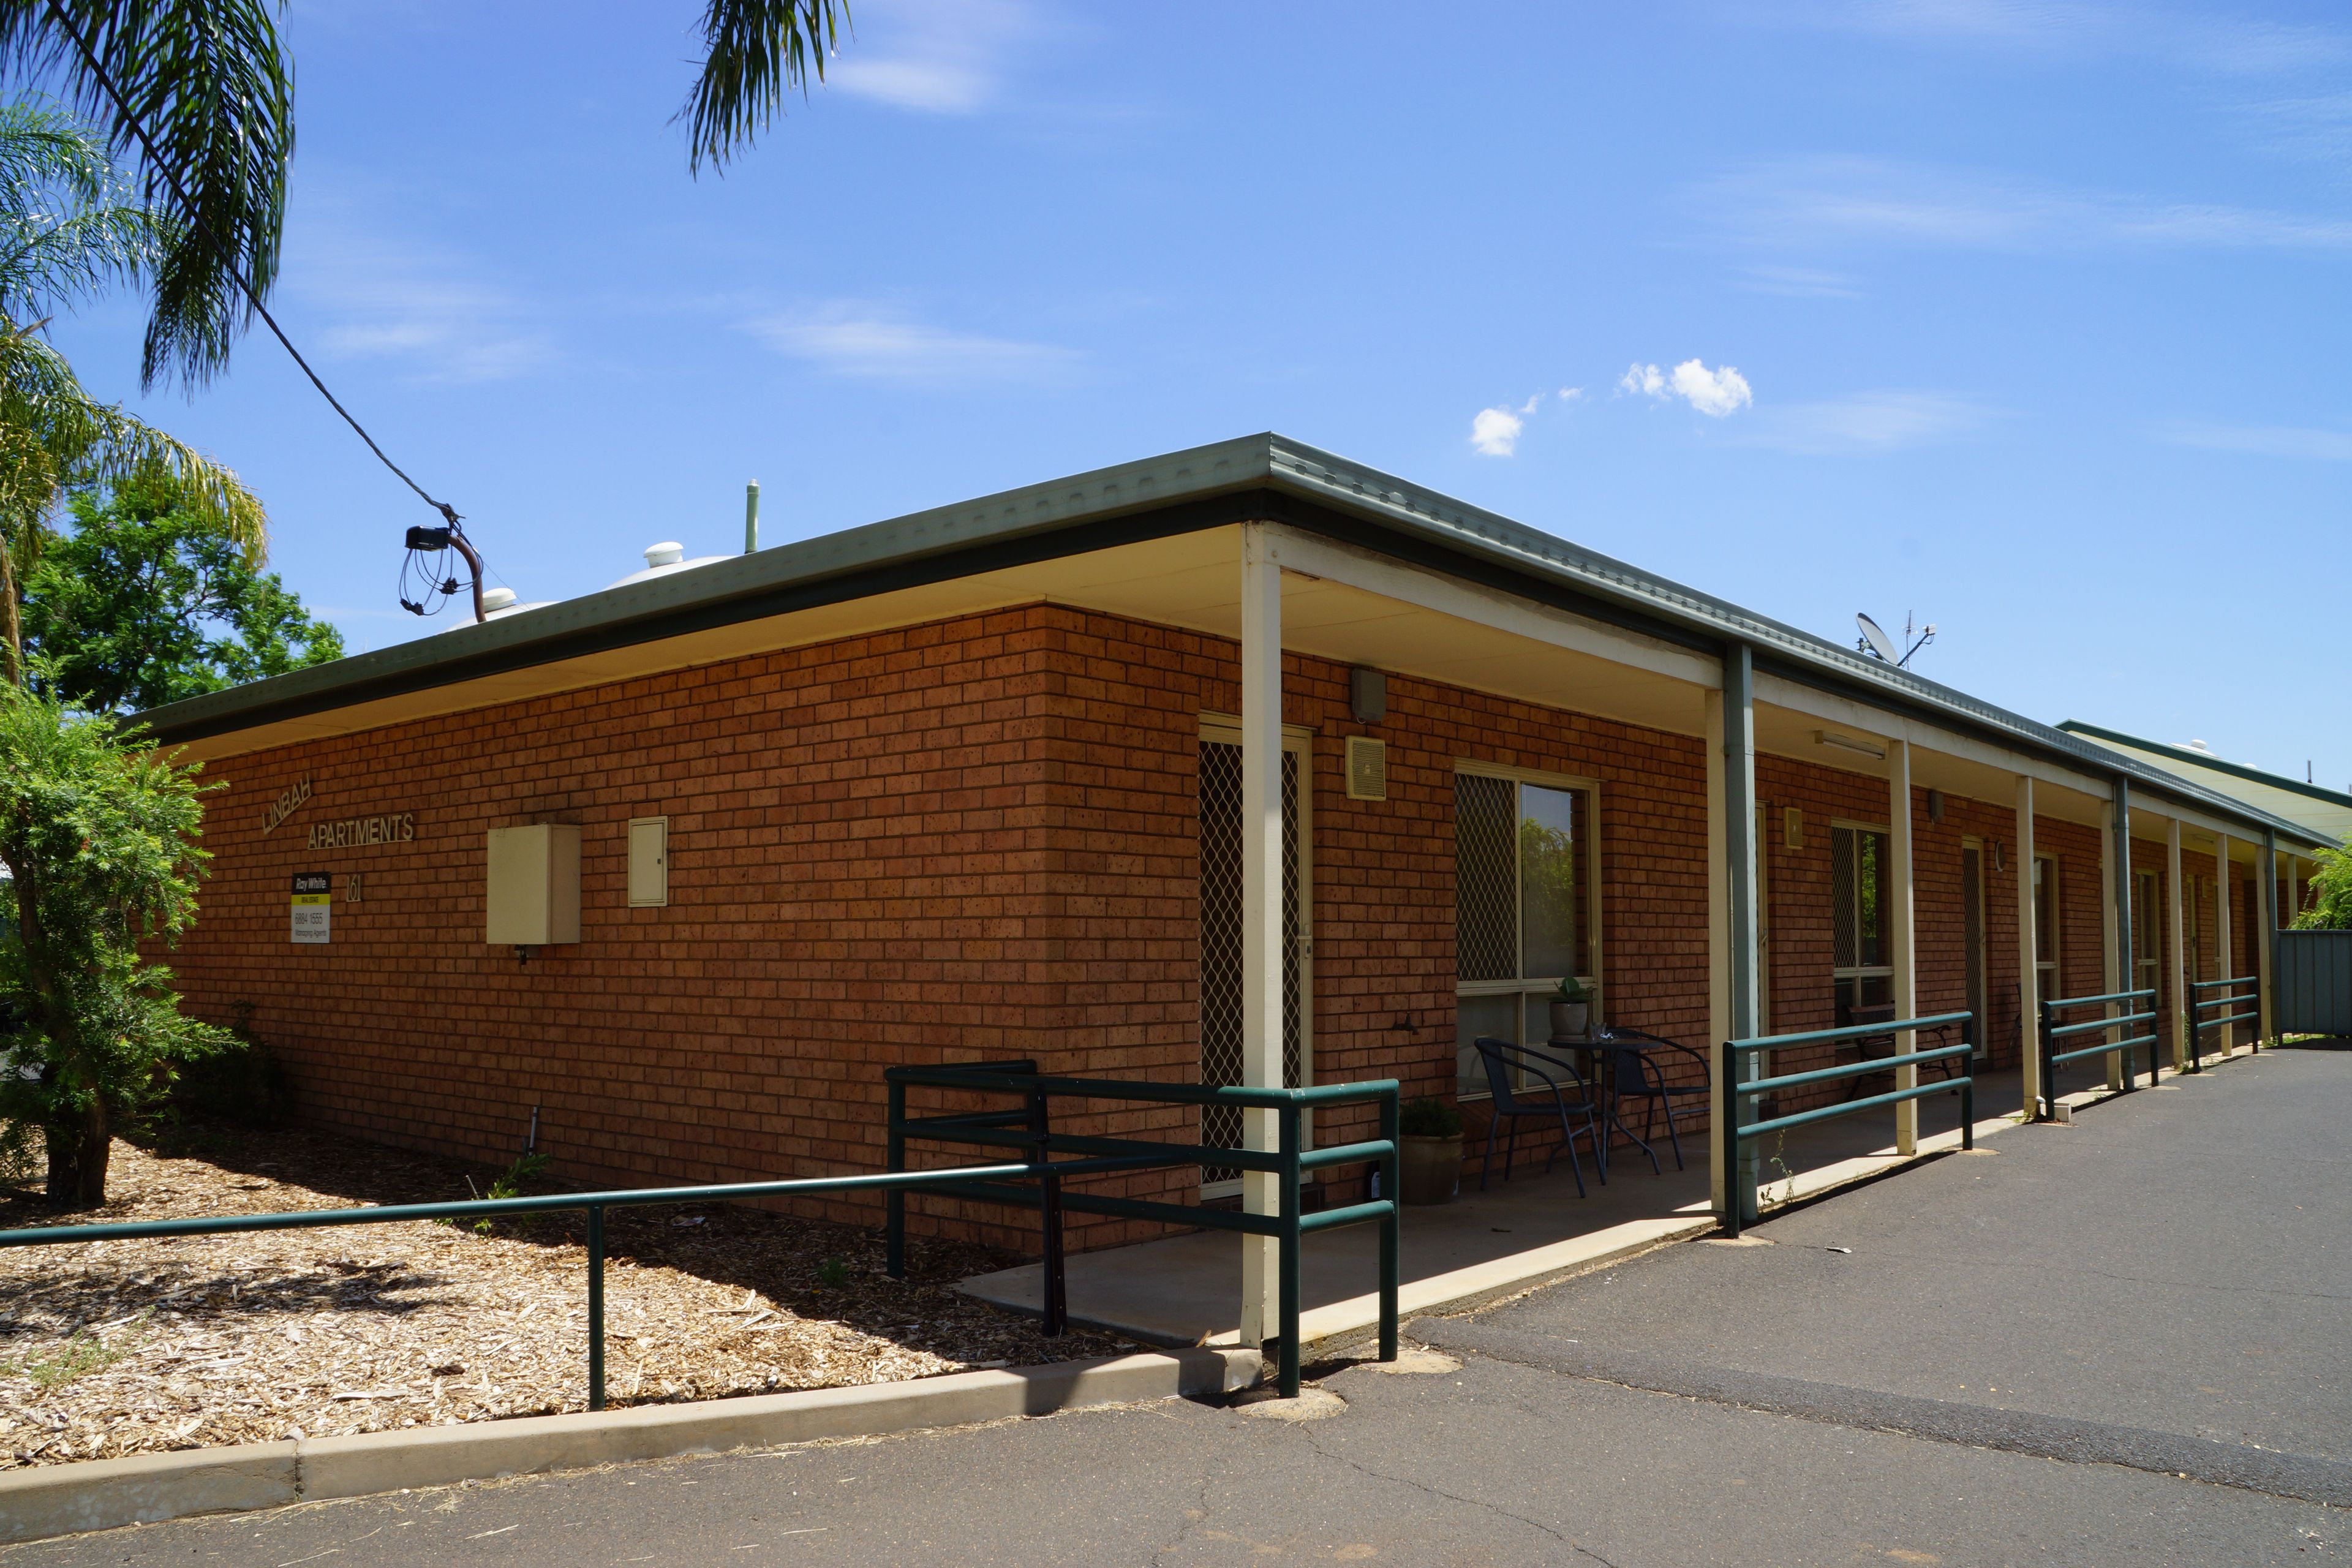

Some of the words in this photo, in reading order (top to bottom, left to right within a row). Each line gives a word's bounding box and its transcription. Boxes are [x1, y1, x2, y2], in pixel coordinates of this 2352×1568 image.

[262, 773, 311, 835] LINBAH
[307, 813, 413, 850] APARTMENTS
[296, 878, 307, 892] Ray
[308, 877, 326, 889] White
[346, 875, 361, 902] 161
[295, 913, 307, 924] 6884
[311, 913, 323, 924] 1555
[295, 930, 313, 938] Managing
[314, 930, 326, 938] Agents
